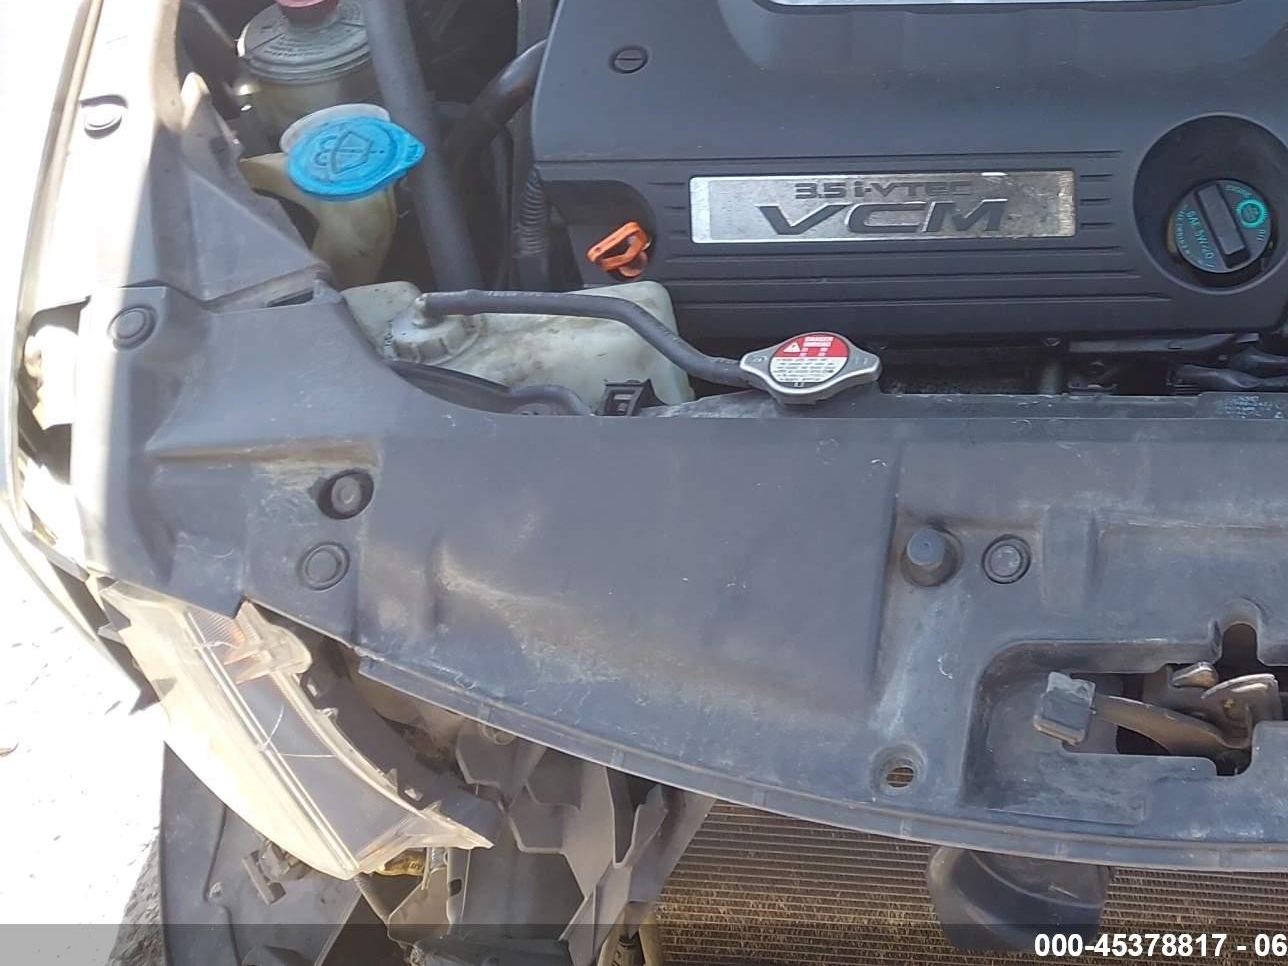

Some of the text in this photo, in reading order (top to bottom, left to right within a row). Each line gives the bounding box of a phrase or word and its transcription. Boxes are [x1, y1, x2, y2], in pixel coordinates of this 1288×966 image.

[794, 180, 971, 200] 3.5 i-VTEC
[755, 198, 1008, 236] VCM
